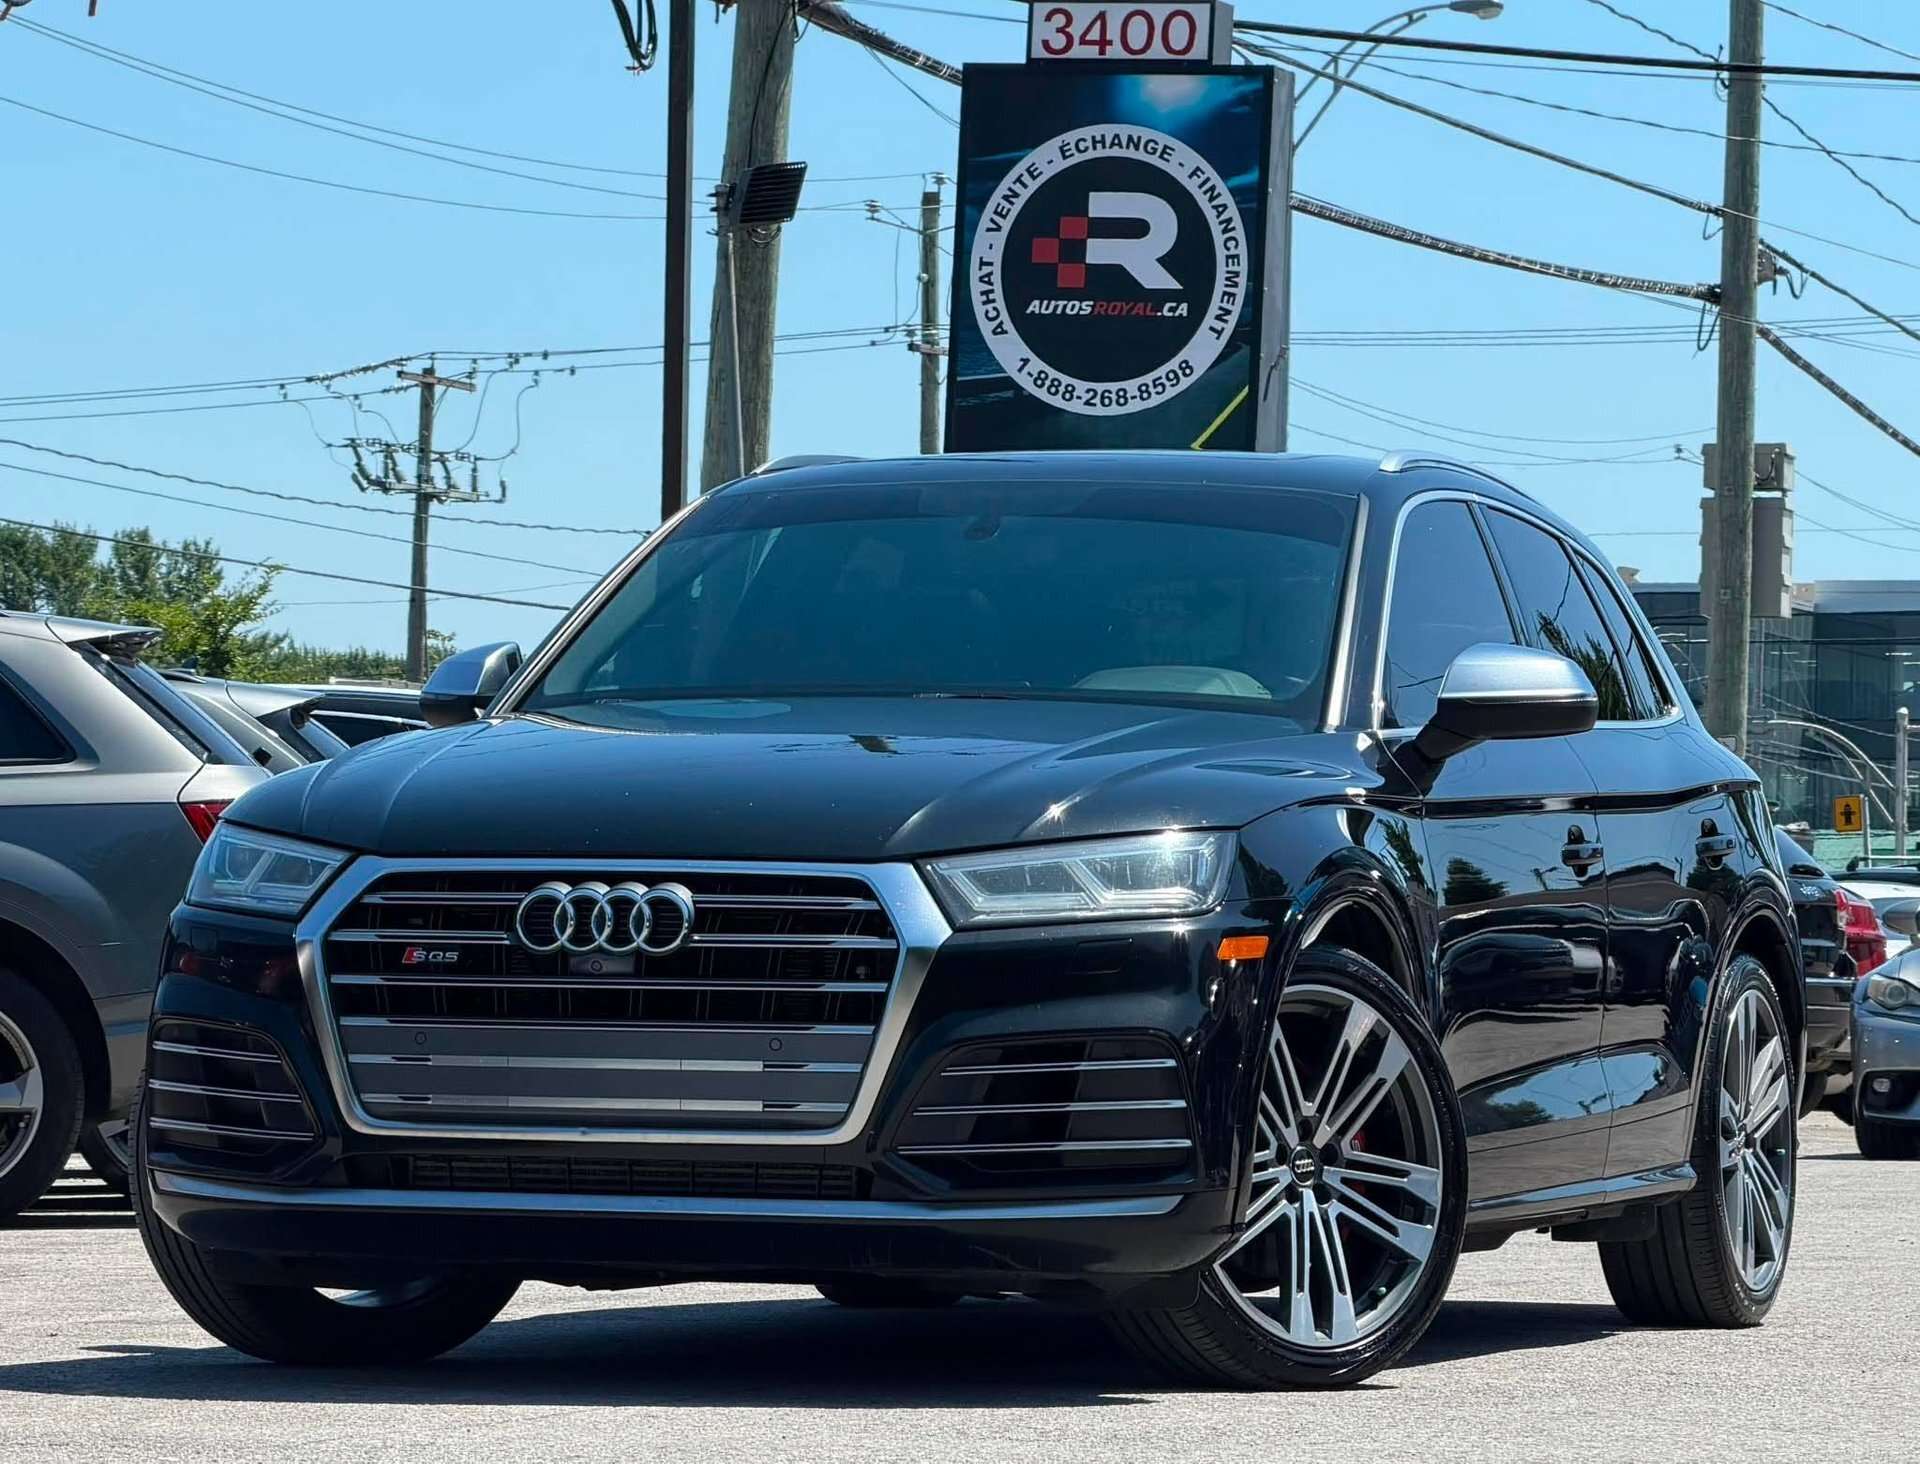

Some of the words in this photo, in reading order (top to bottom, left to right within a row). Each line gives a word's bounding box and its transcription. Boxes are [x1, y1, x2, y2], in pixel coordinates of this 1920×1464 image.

[1041, 8, 1198, 57] 3400
[1058, 133, 1176, 164] ÉCHANGE
[985, 162, 1044, 233] VENTE
[1085, 191, 1184, 289] R
[1187, 165, 1242, 341] FINANCEMENT
[978, 256, 1009, 337] ACHAT
[1016, 357, 1195, 408] 1-888-268-8598
[409, 948, 459, 962] SQ5
